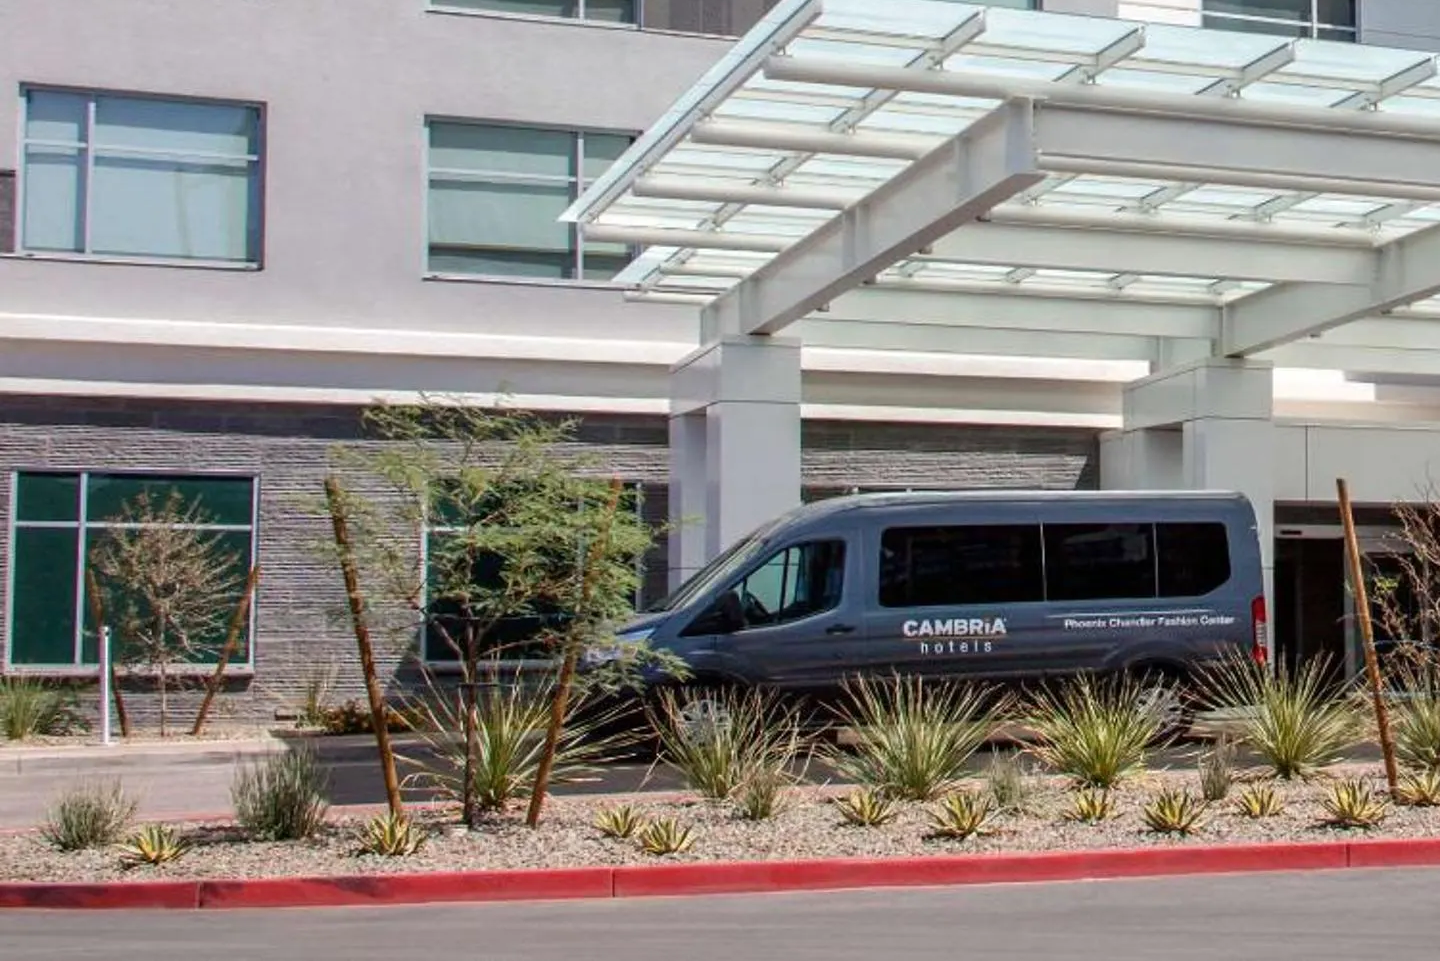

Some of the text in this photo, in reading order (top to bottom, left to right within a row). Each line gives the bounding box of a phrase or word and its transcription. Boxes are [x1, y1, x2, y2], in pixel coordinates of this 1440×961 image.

[1064, 615, 1235, 630] Phoenix Chandler Fashion Center
[920, 640, 992, 654] hotels
